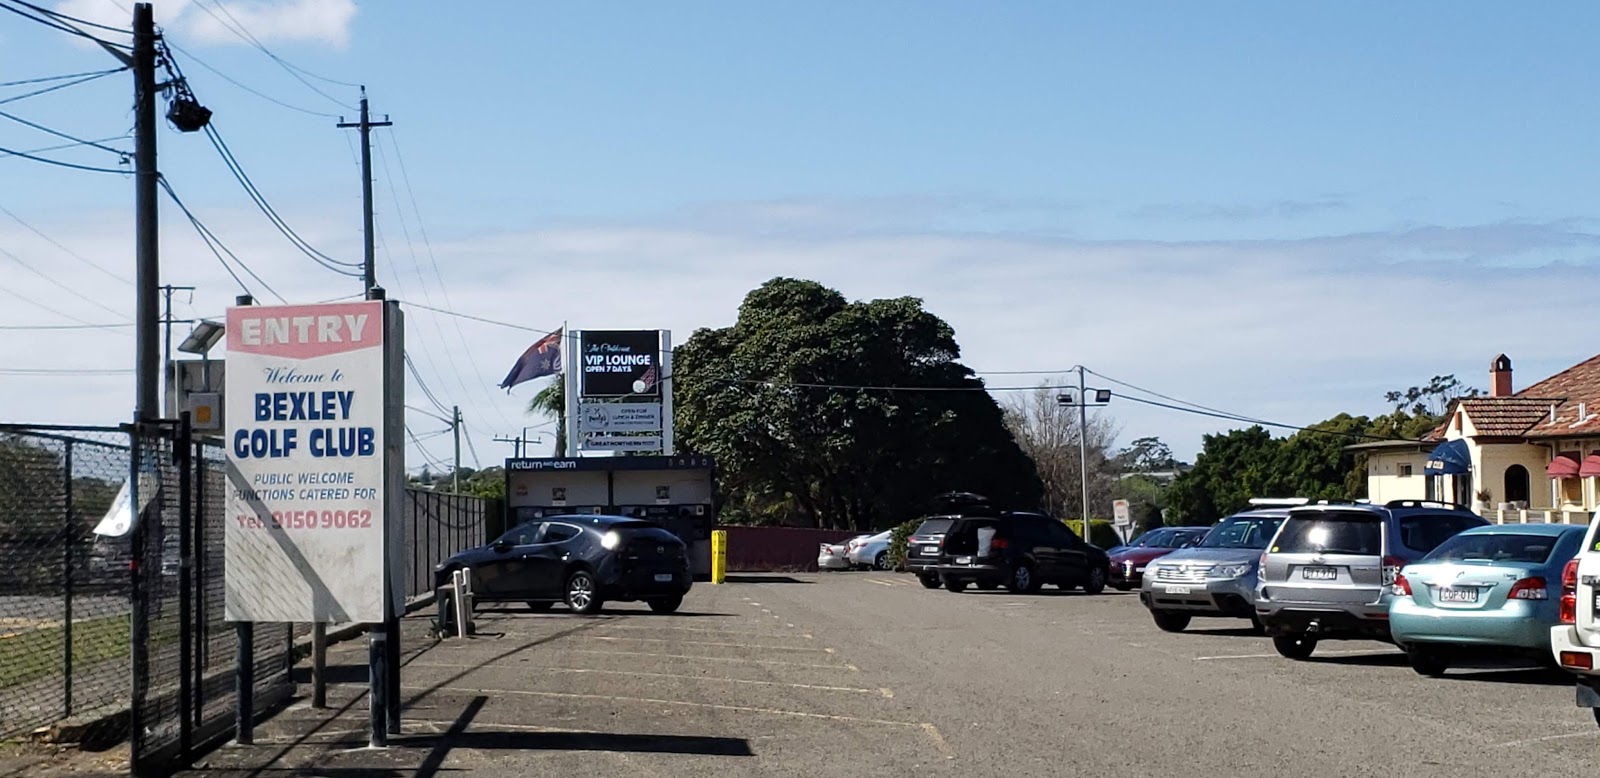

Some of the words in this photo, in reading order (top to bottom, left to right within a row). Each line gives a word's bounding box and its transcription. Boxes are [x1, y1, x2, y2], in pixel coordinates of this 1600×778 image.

[241, 313, 369, 346] ENTRY
[585, 355, 604, 366] VIP
[606, 355, 651, 365] LOUNGE
[263, 367, 326, 384] Welcome
[331, 368, 345, 383] to
[254, 390, 355, 422] BEXLEY
[234, 428, 297, 459] GOLF
[309, 426, 376, 458] CLUB
[511, 460, 543, 470] return
[553, 460, 577, 469] earn
[254, 473, 293, 485] PUBLIC
[298, 472, 355, 484] WELCOME
[232, 488, 296, 501] FUNCTIONS
[299, 488, 350, 500] CATERED
[354, 487, 377, 499] FOR
[272, 510, 318, 530] 9150
[321, 509, 372, 529] 9062
